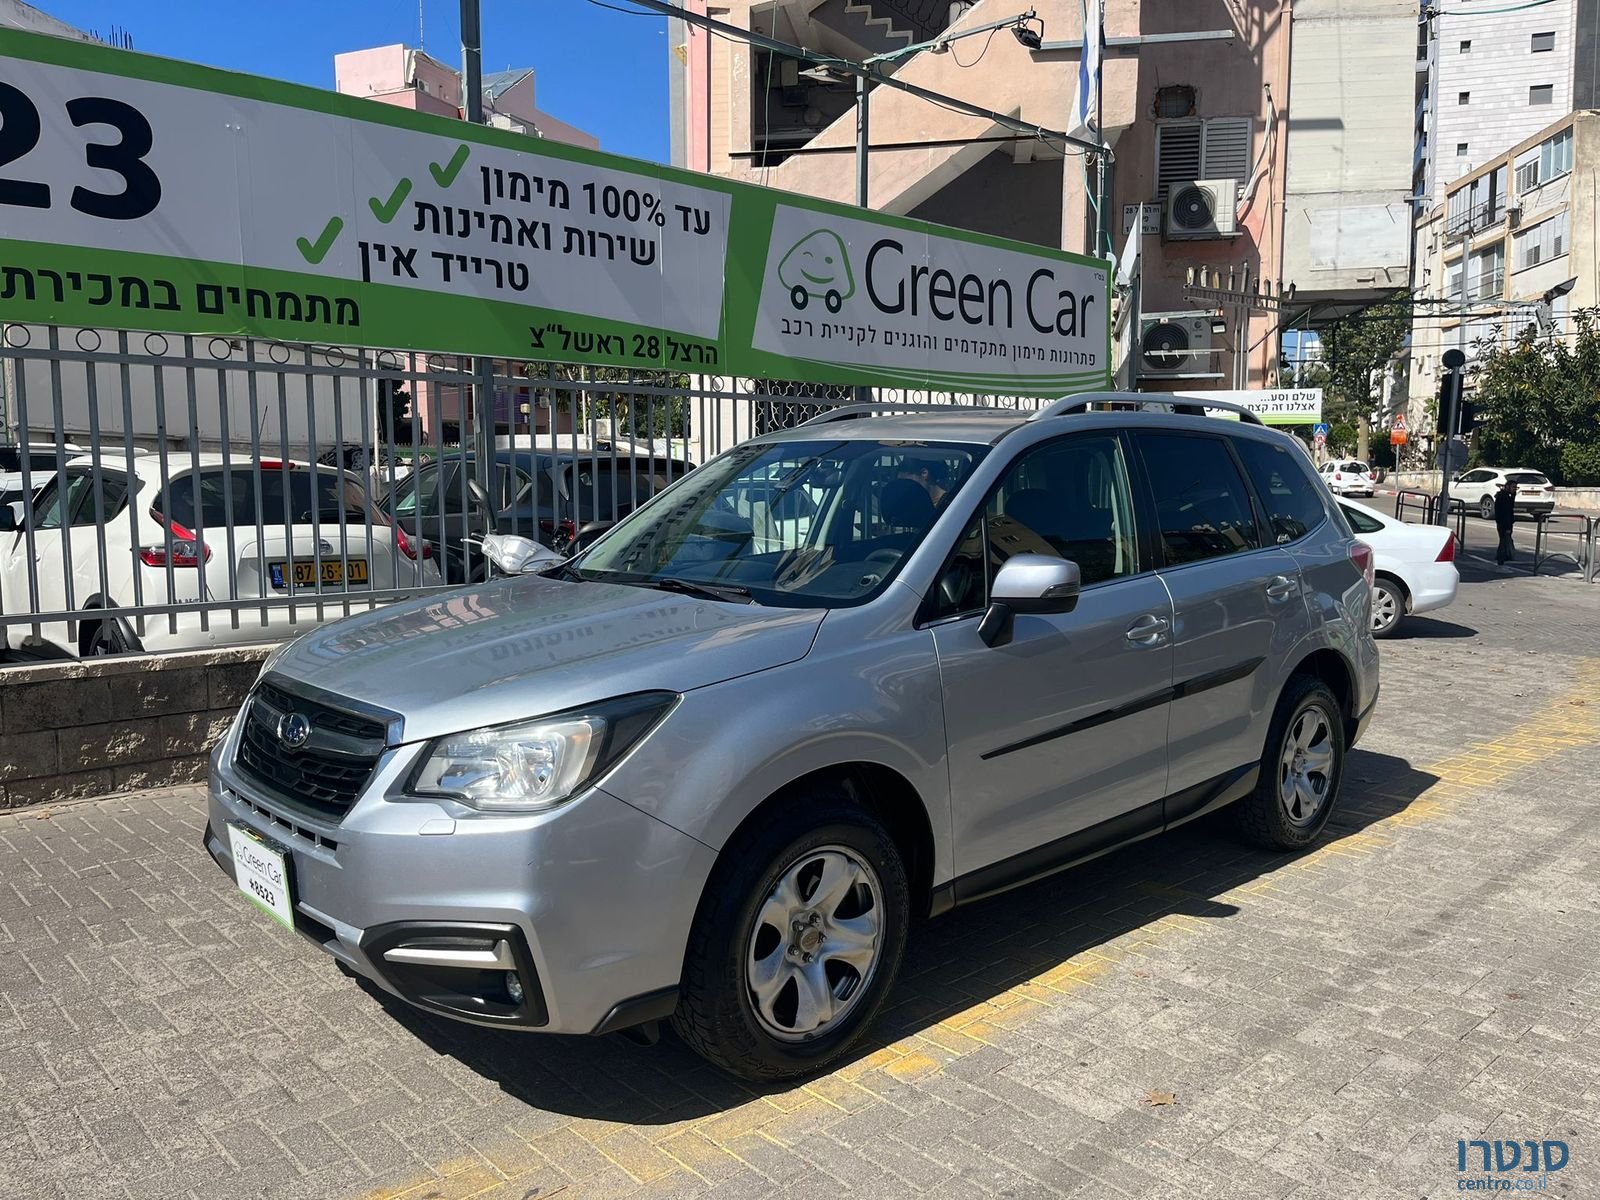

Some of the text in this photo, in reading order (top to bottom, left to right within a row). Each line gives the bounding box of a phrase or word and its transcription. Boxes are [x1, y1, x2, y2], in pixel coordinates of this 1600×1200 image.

[480, 165, 711, 235] עד 100% מימון
[413, 201, 656, 266] שירות ואמינות
[358, 241, 530, 291] טרייד אין
[1, 266, 360, 327] מתמחים במכירת
[865, 238, 1095, 338] Green Car
[632, 334, 660, 360] 28
[667, 336, 718, 365] הרצל
[781, 318, 1096, 366] פתרונות מימון מתקדמים והוגנים לקניית רכב
[1249, 403, 1269, 413] קצת
[1271, 403, 1283, 411] זה
[1286, 402, 1316, 411] אצלנו
[1292, 391, 1316, 401] שלם
[243, 846, 268, 876] Green
[267, 862, 282, 886] Car
